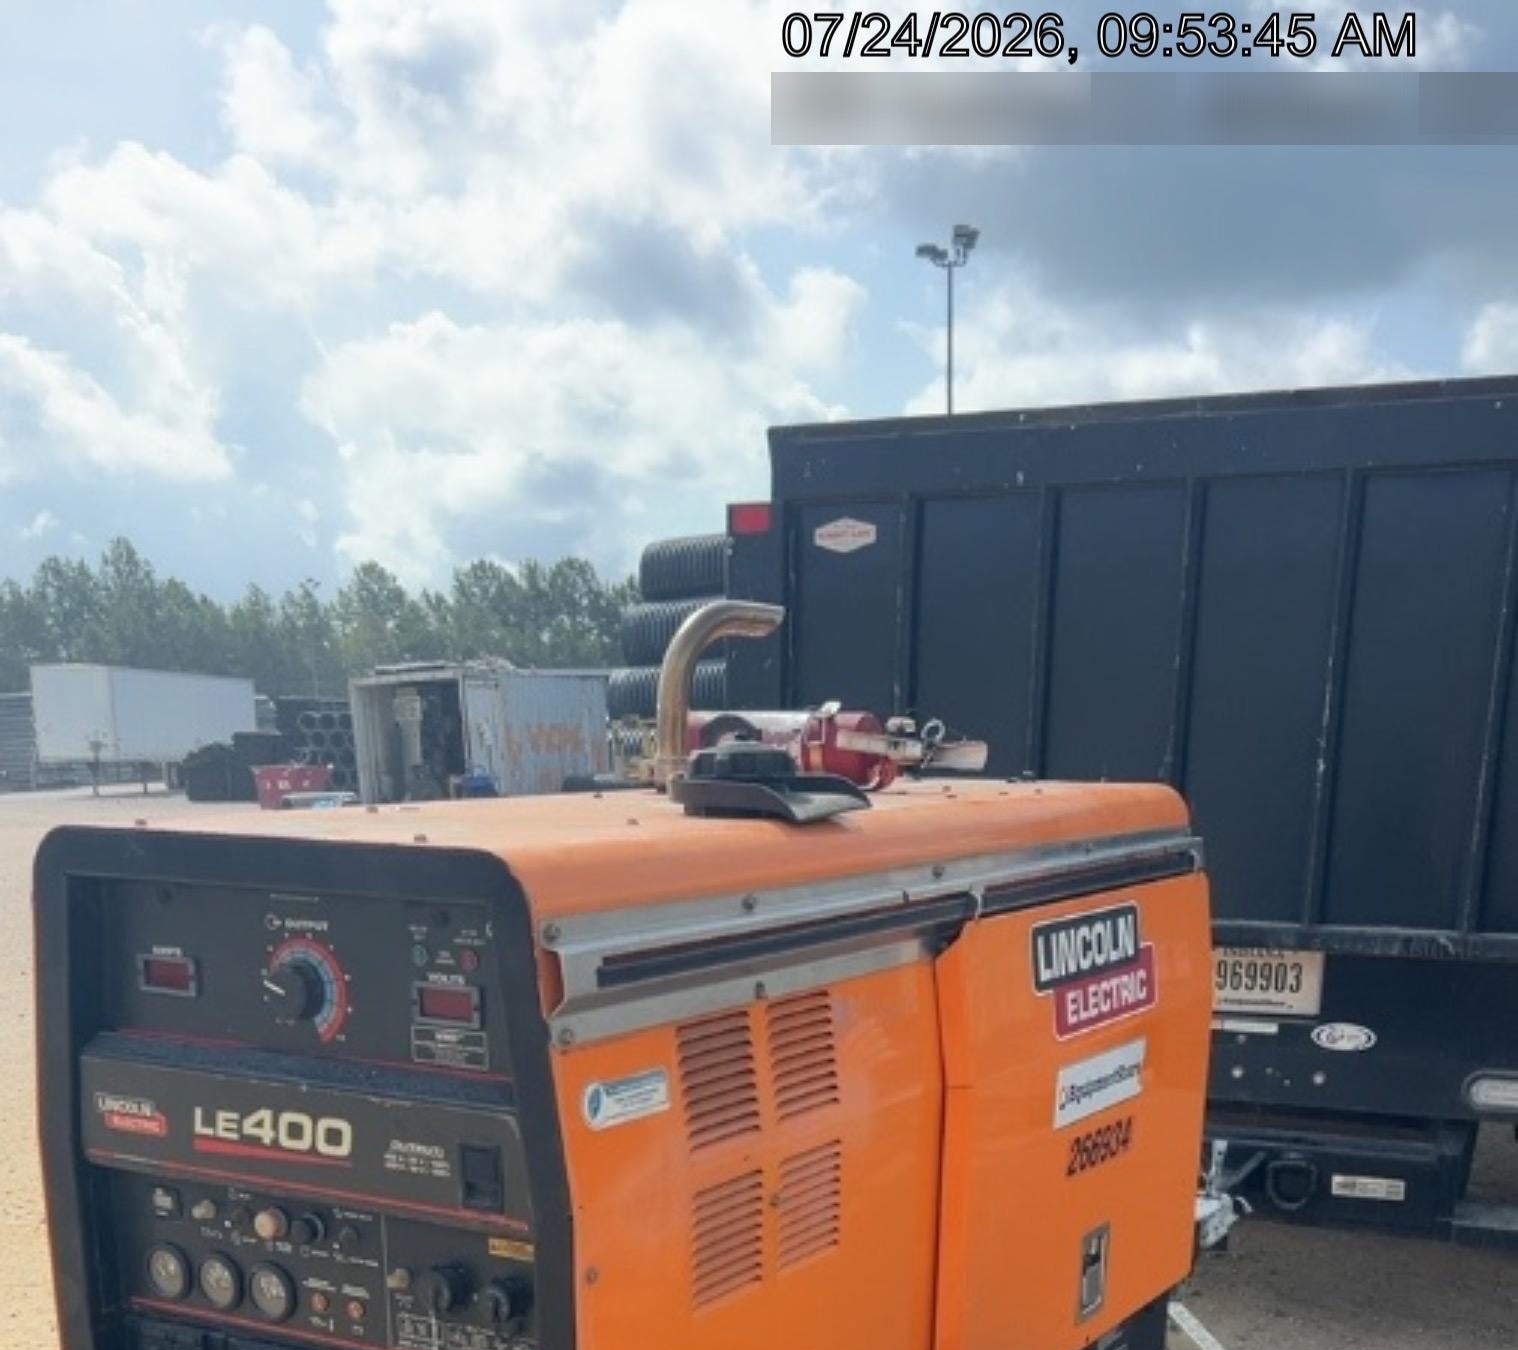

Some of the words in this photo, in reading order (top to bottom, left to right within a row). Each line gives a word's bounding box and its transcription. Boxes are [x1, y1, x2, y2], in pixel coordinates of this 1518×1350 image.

[1037, 914, 1136, 982] LINCOLN
[1066, 969, 1148, 1026] ELECTRIC
[1215, 959, 1304, 993] 969903
[194, 1106, 353, 1157] LE400
